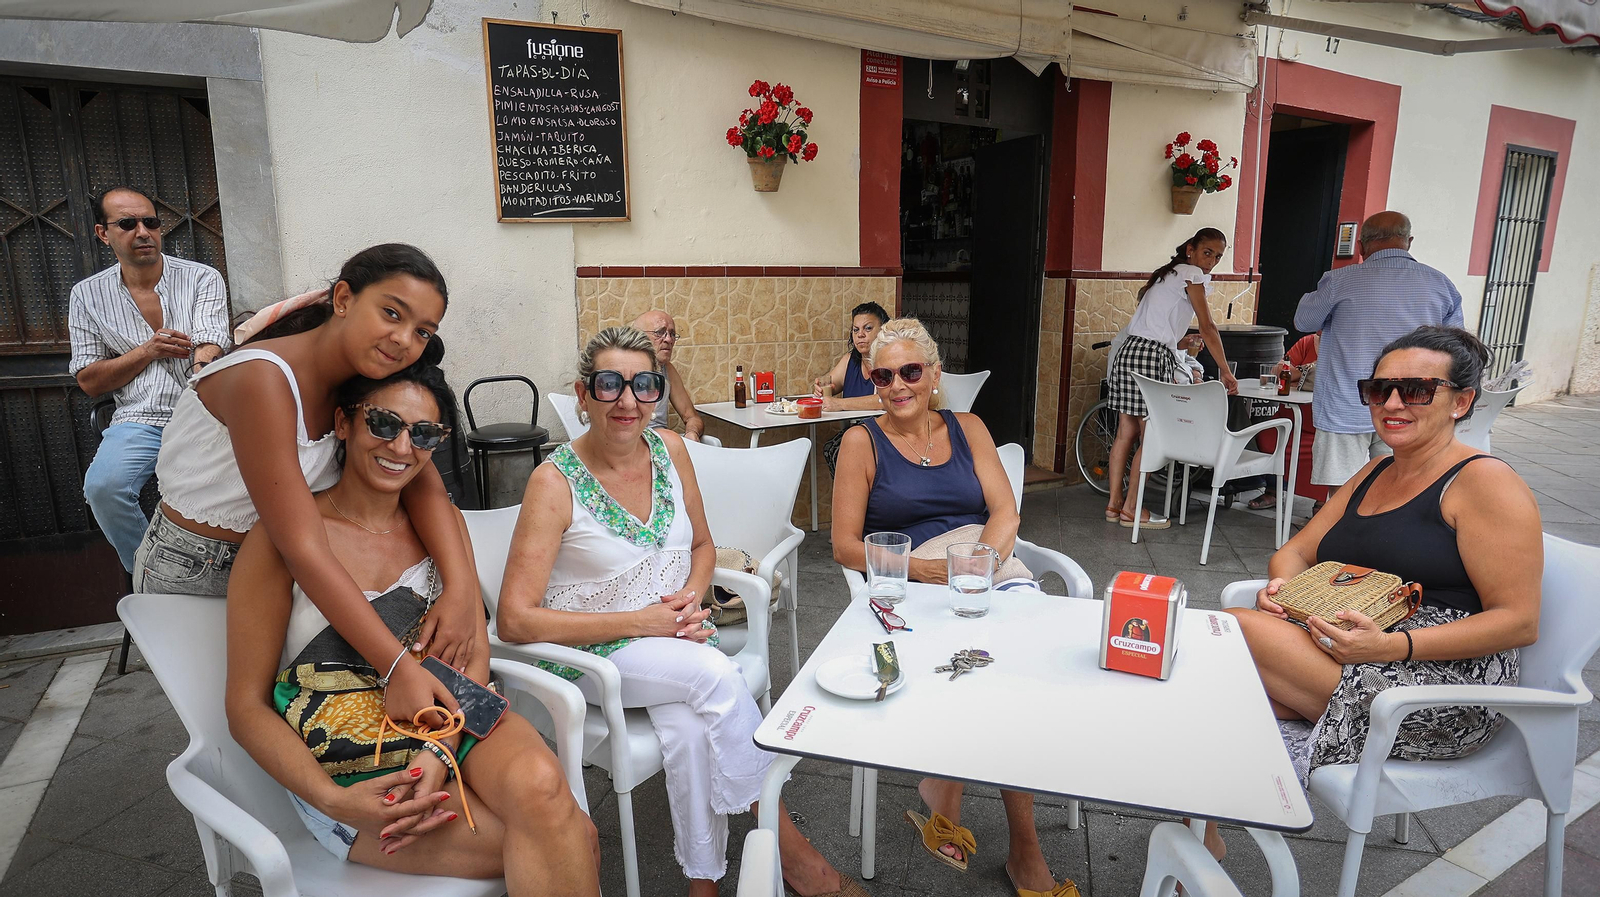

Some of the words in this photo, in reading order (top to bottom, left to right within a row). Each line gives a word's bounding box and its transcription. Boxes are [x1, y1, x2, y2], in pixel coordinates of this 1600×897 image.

[526, 39, 584, 59] fusione
[1325, 36, 1340, 54] 17
[500, 183, 572, 194] BANDERILLAS
[1113, 637, 1157, 653] Cruzcampo
[1121, 650, 1147, 659] ESPECIAL
[777, 710, 796, 731] ESPECIAL
[784, 705, 816, 741] Cruzcampo
